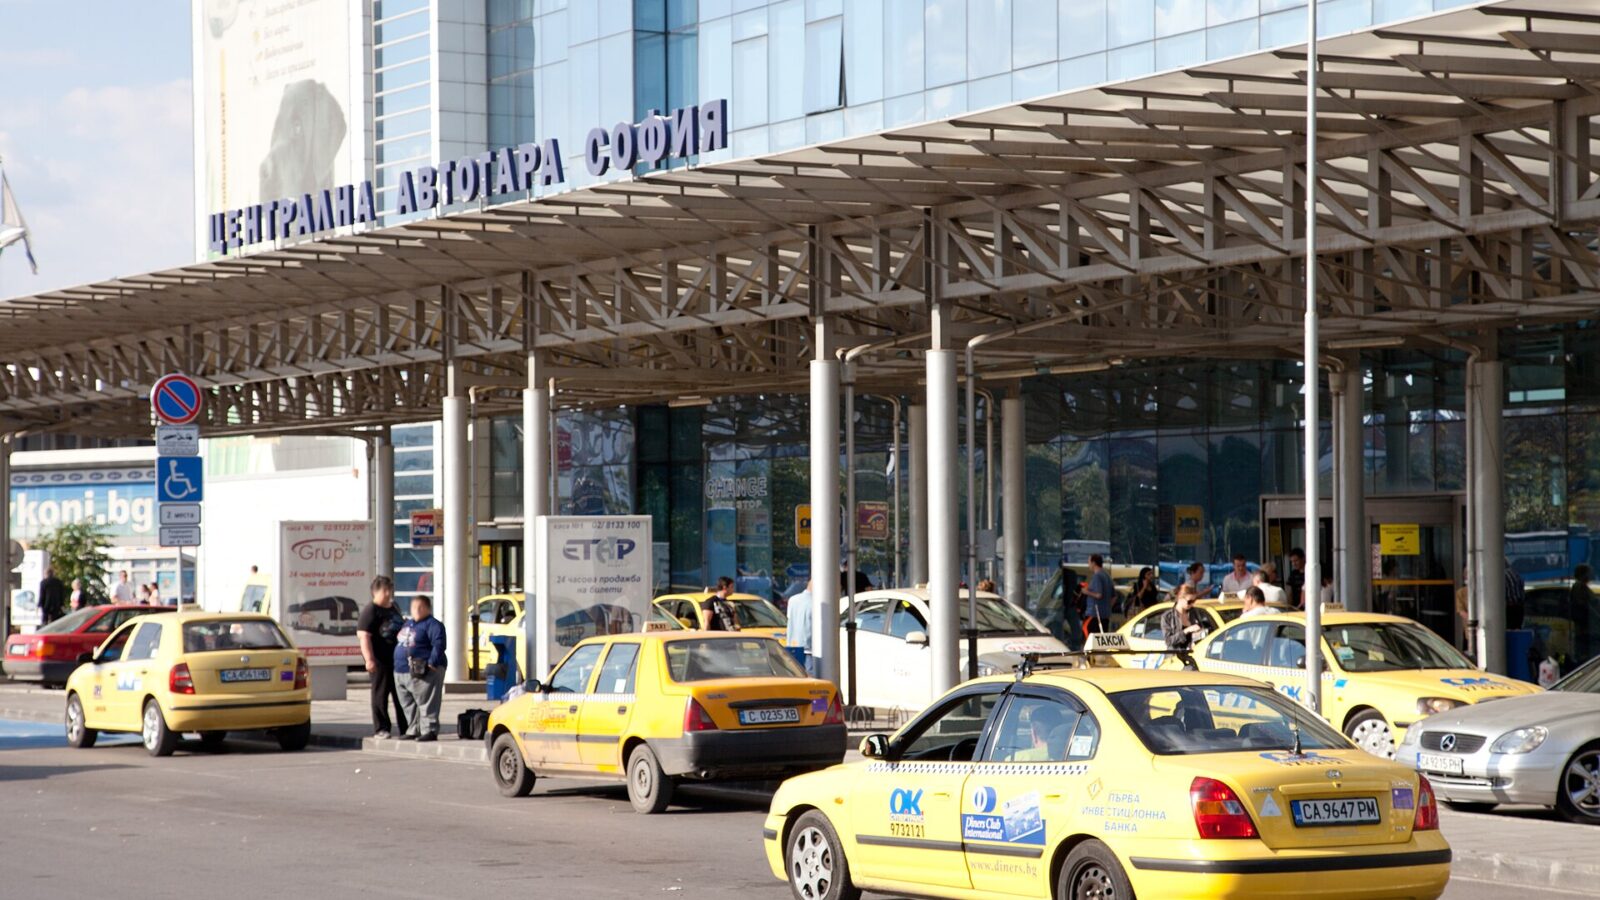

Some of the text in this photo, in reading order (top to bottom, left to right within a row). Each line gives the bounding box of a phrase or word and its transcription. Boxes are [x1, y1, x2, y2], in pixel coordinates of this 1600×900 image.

[208, 98, 728, 254] ЦЕНТРАЛНА АВТОГАРА СОФИЯ
[705, 477, 767, 498] CHANGE
[736, 500, 762, 509] STOP
[298, 544, 344, 562] Grup
[563, 537, 635, 564] ETAP
[599, 575, 641, 585] продажба
[590, 586, 622, 594] билети
[1095, 635, 1125, 646] ТАКСИ
[760, 710, 784, 721] 0235
[1109, 793, 1140, 803] ПЪРВА
[1082, 806, 1166, 820] ИНВЕСТИЦИОННА
[1358, 801, 1376, 818] PM
[966, 816, 1001, 830] Diners Club
[1104, 821, 1138, 832] БАНКА
[890, 823, 925, 838] 9732121
[965, 829, 1003, 840] International
[970, 860, 1037, 877] www.diners.bg
